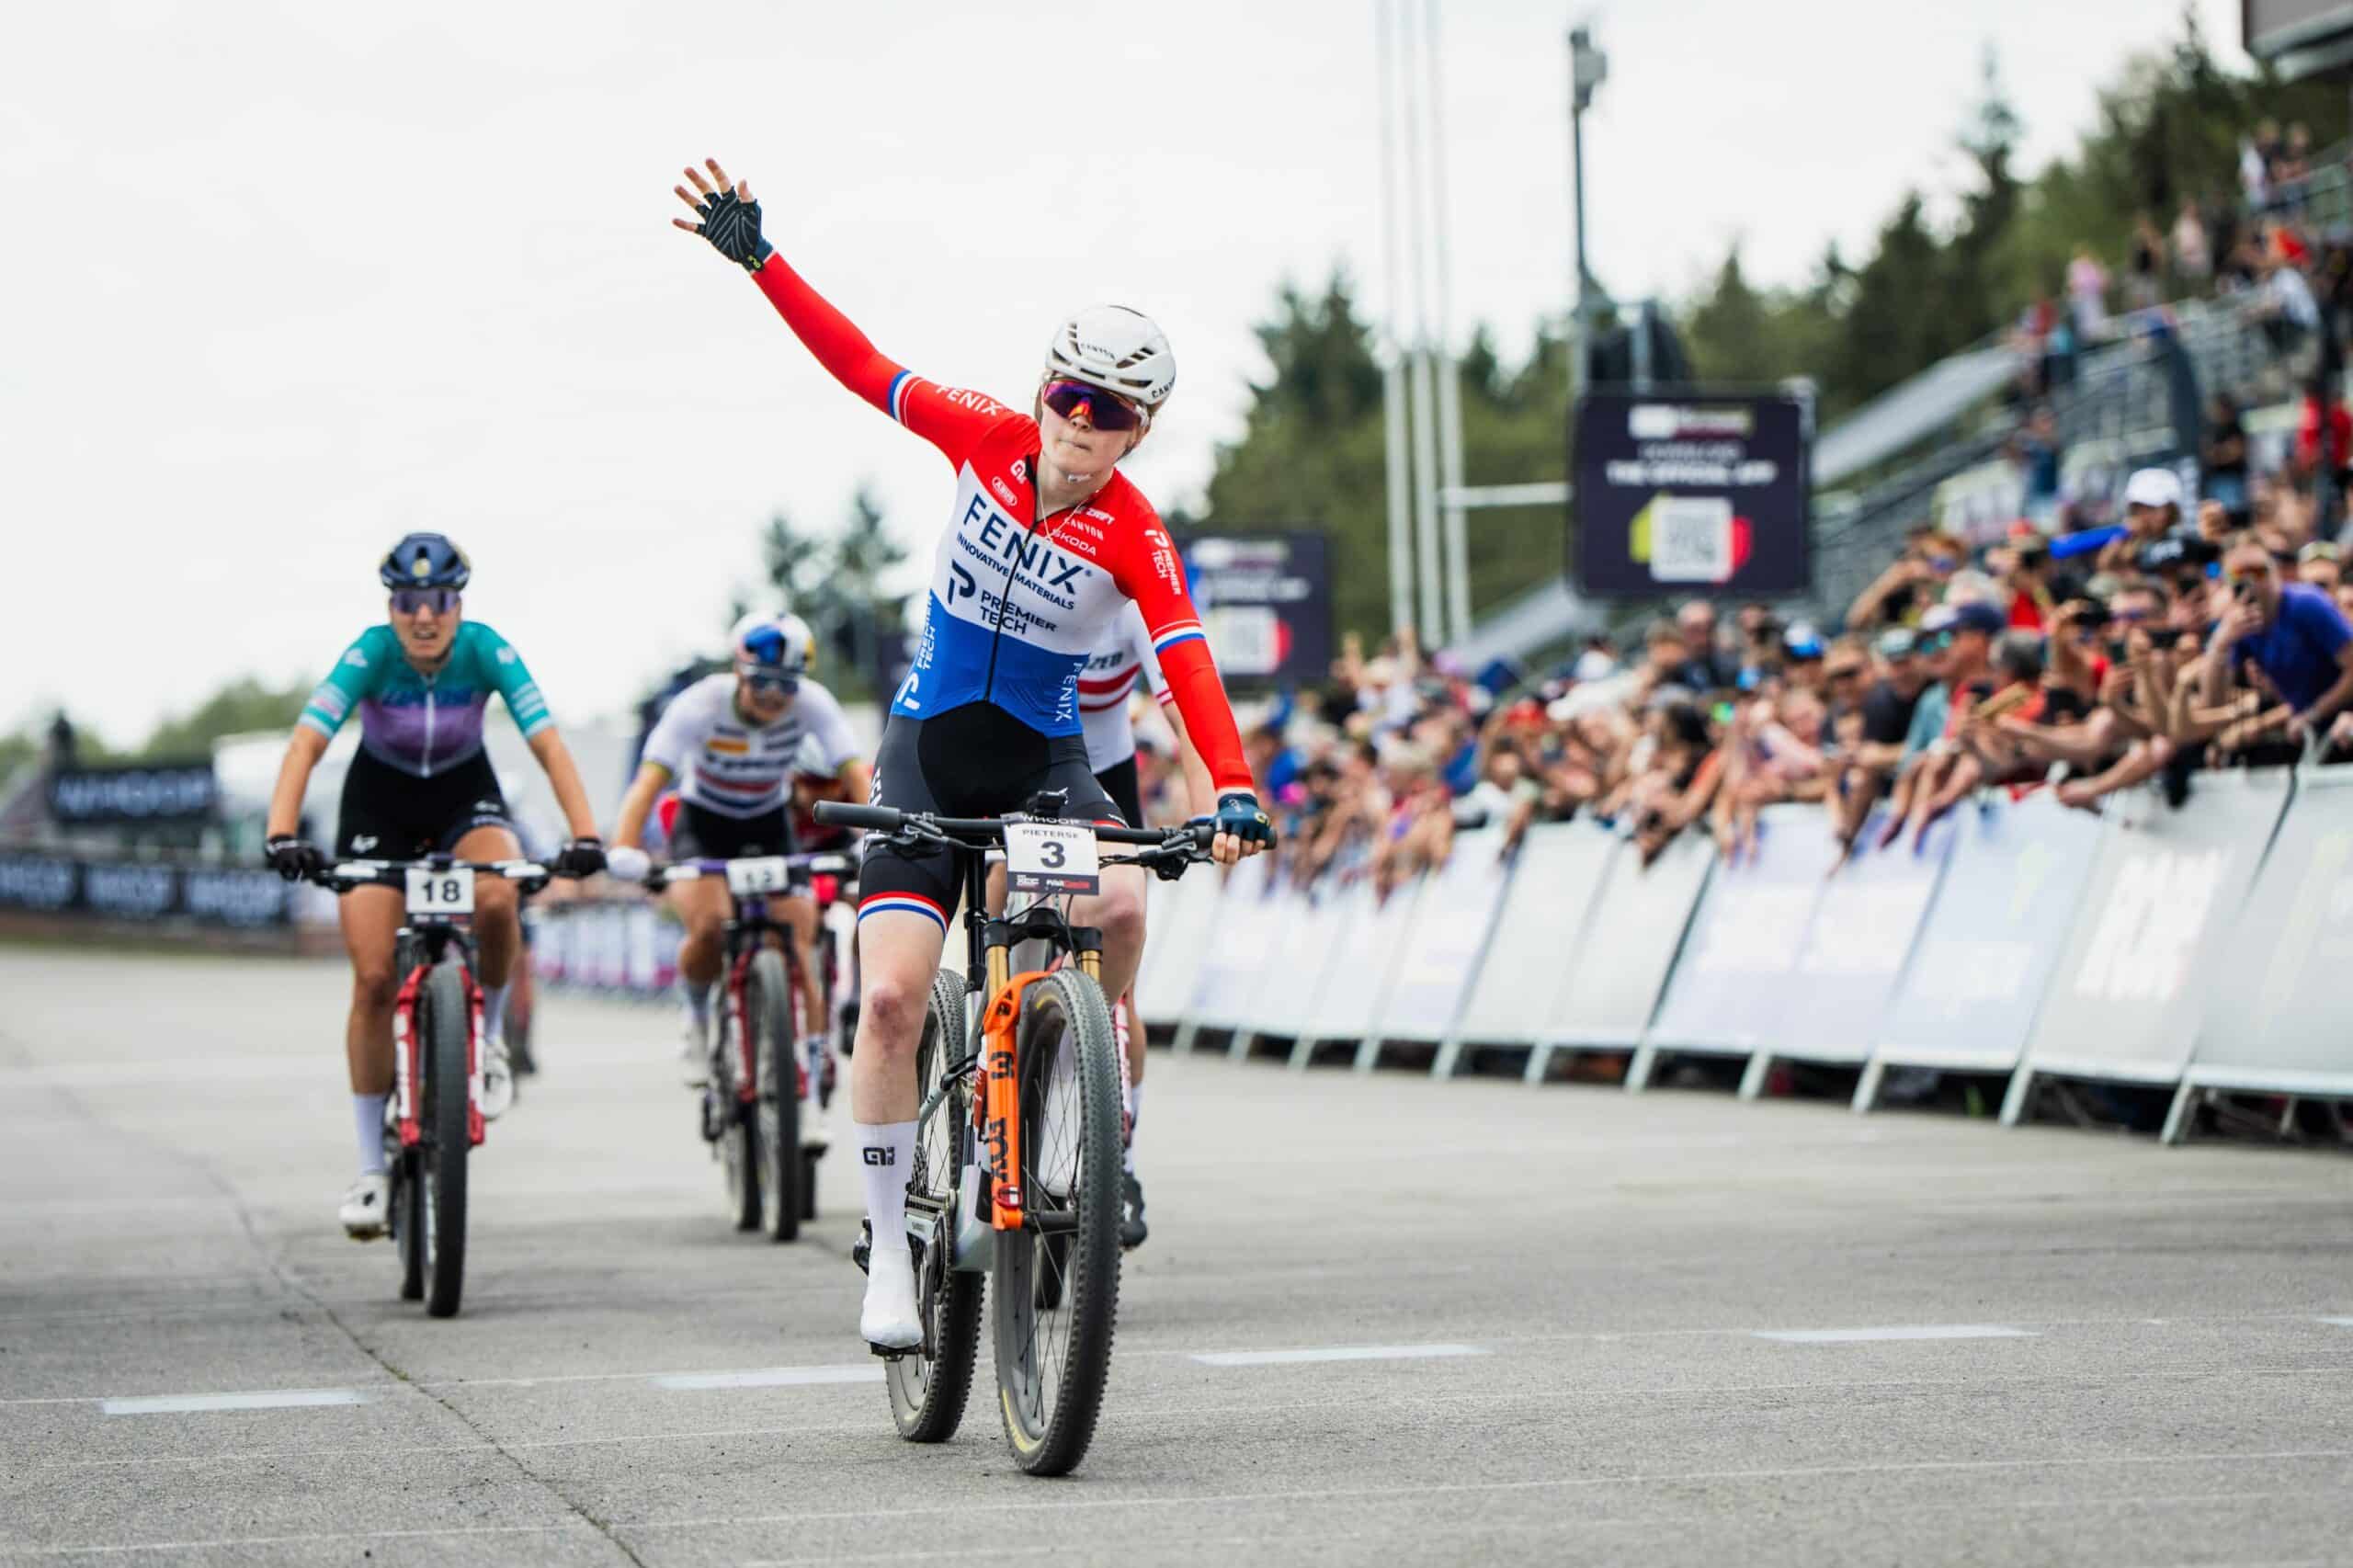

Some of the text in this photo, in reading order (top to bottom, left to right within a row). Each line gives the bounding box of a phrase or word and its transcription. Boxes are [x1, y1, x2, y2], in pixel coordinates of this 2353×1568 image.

[936, 386, 1002, 416] FENIX
[962, 493, 1084, 595] FENIX
[957, 531, 1075, 610] INNOVATIVE MATERIALS
[979, 605, 1028, 635] TECH
[980, 588, 1057, 633] PREMIER
[1054, 662, 1084, 722] FENIX
[1022, 829, 1080, 839] PIETERSE
[1040, 841, 1066, 869] 3
[422, 879, 460, 903] 18
